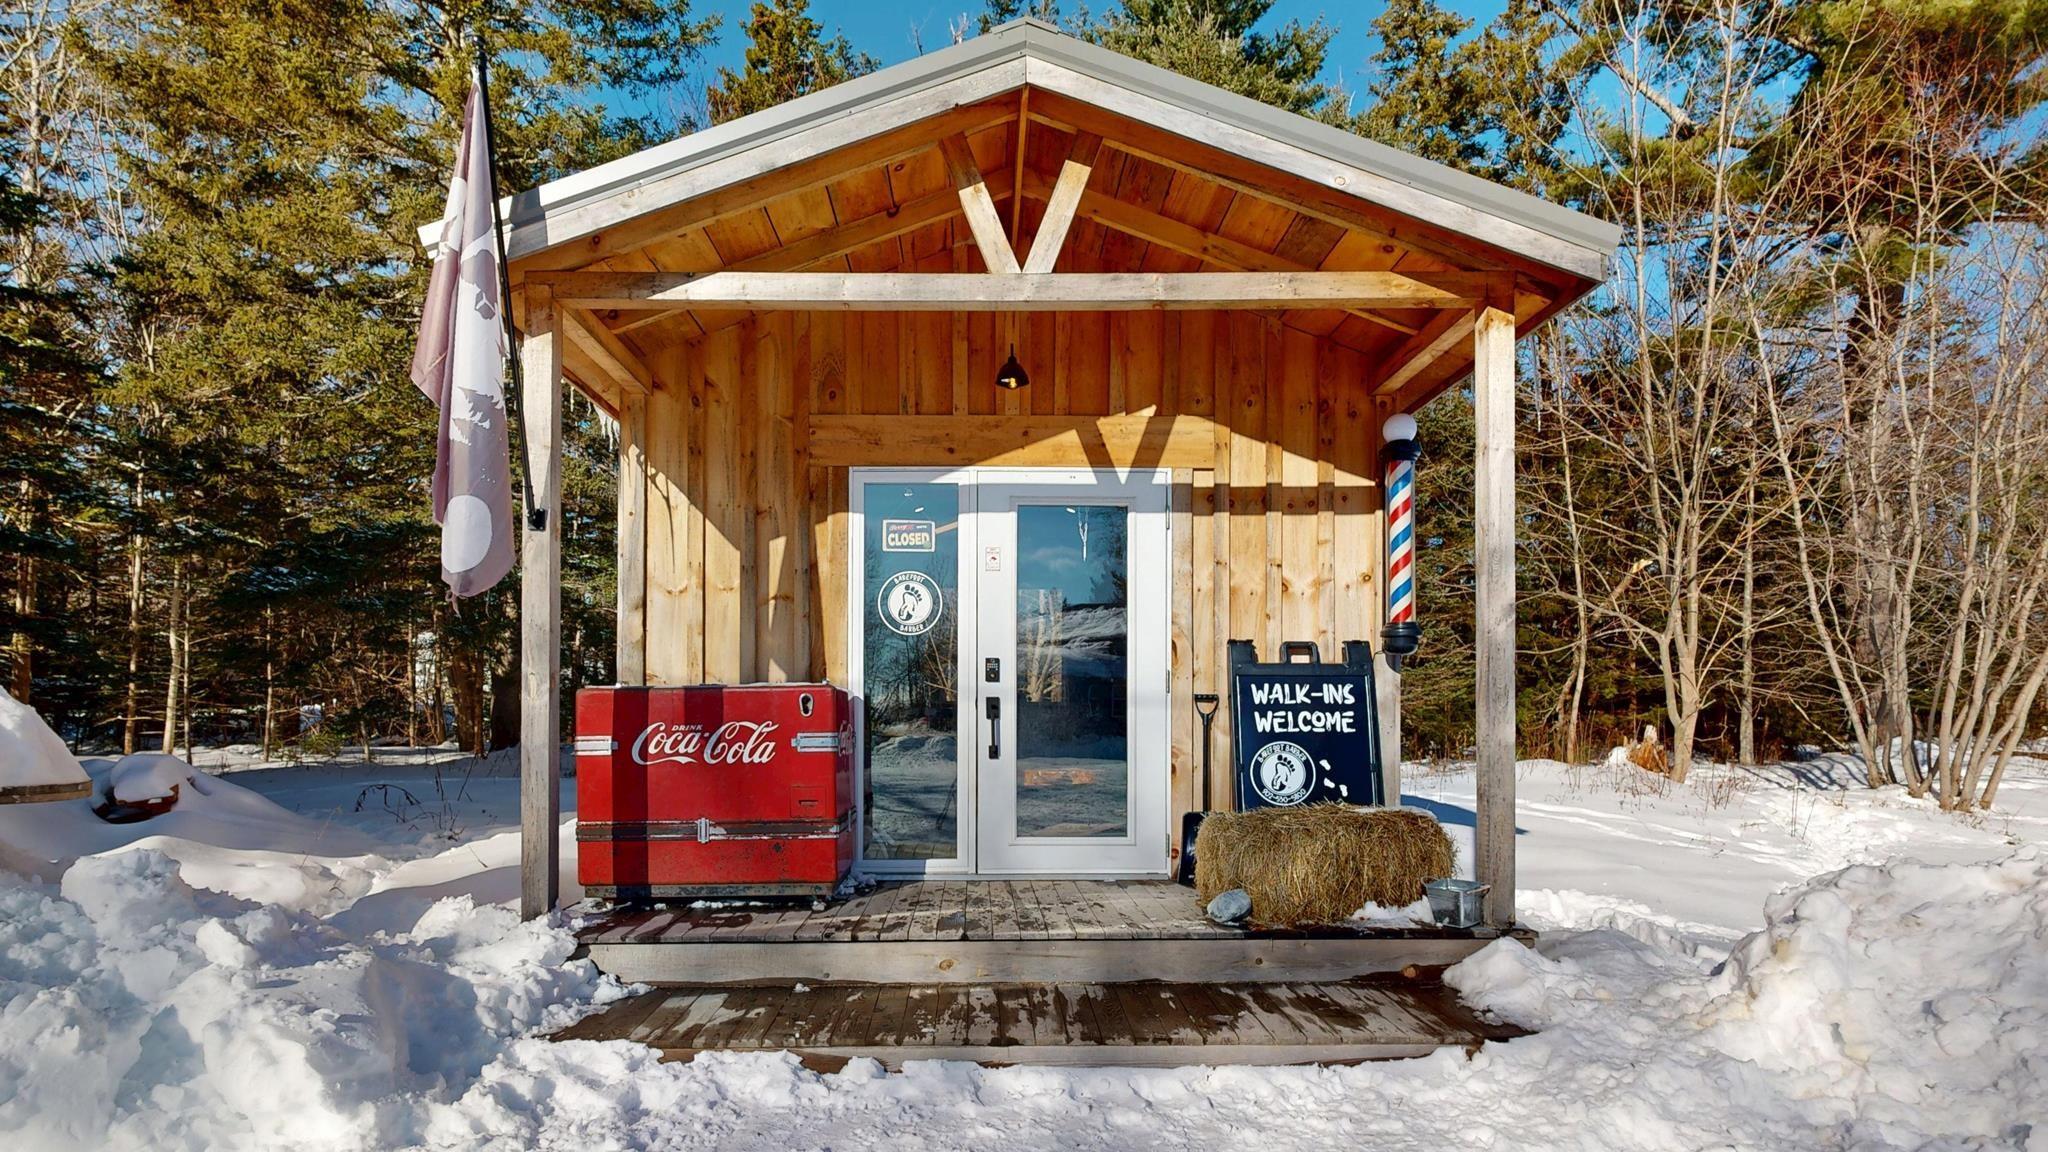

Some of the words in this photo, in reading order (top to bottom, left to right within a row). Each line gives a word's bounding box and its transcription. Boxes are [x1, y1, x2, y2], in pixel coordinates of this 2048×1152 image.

[888, 532, 930, 546] CLOSED
[893, 573, 925, 584] BAREFOOT
[899, 624, 924, 632] BARBER
[1250, 683, 1355, 705] WALK-INS
[1254, 711, 1356, 733] WELCOME
[631, 720, 779, 765] Coca-Cola
[1285, 744, 1307, 761] BARBER
